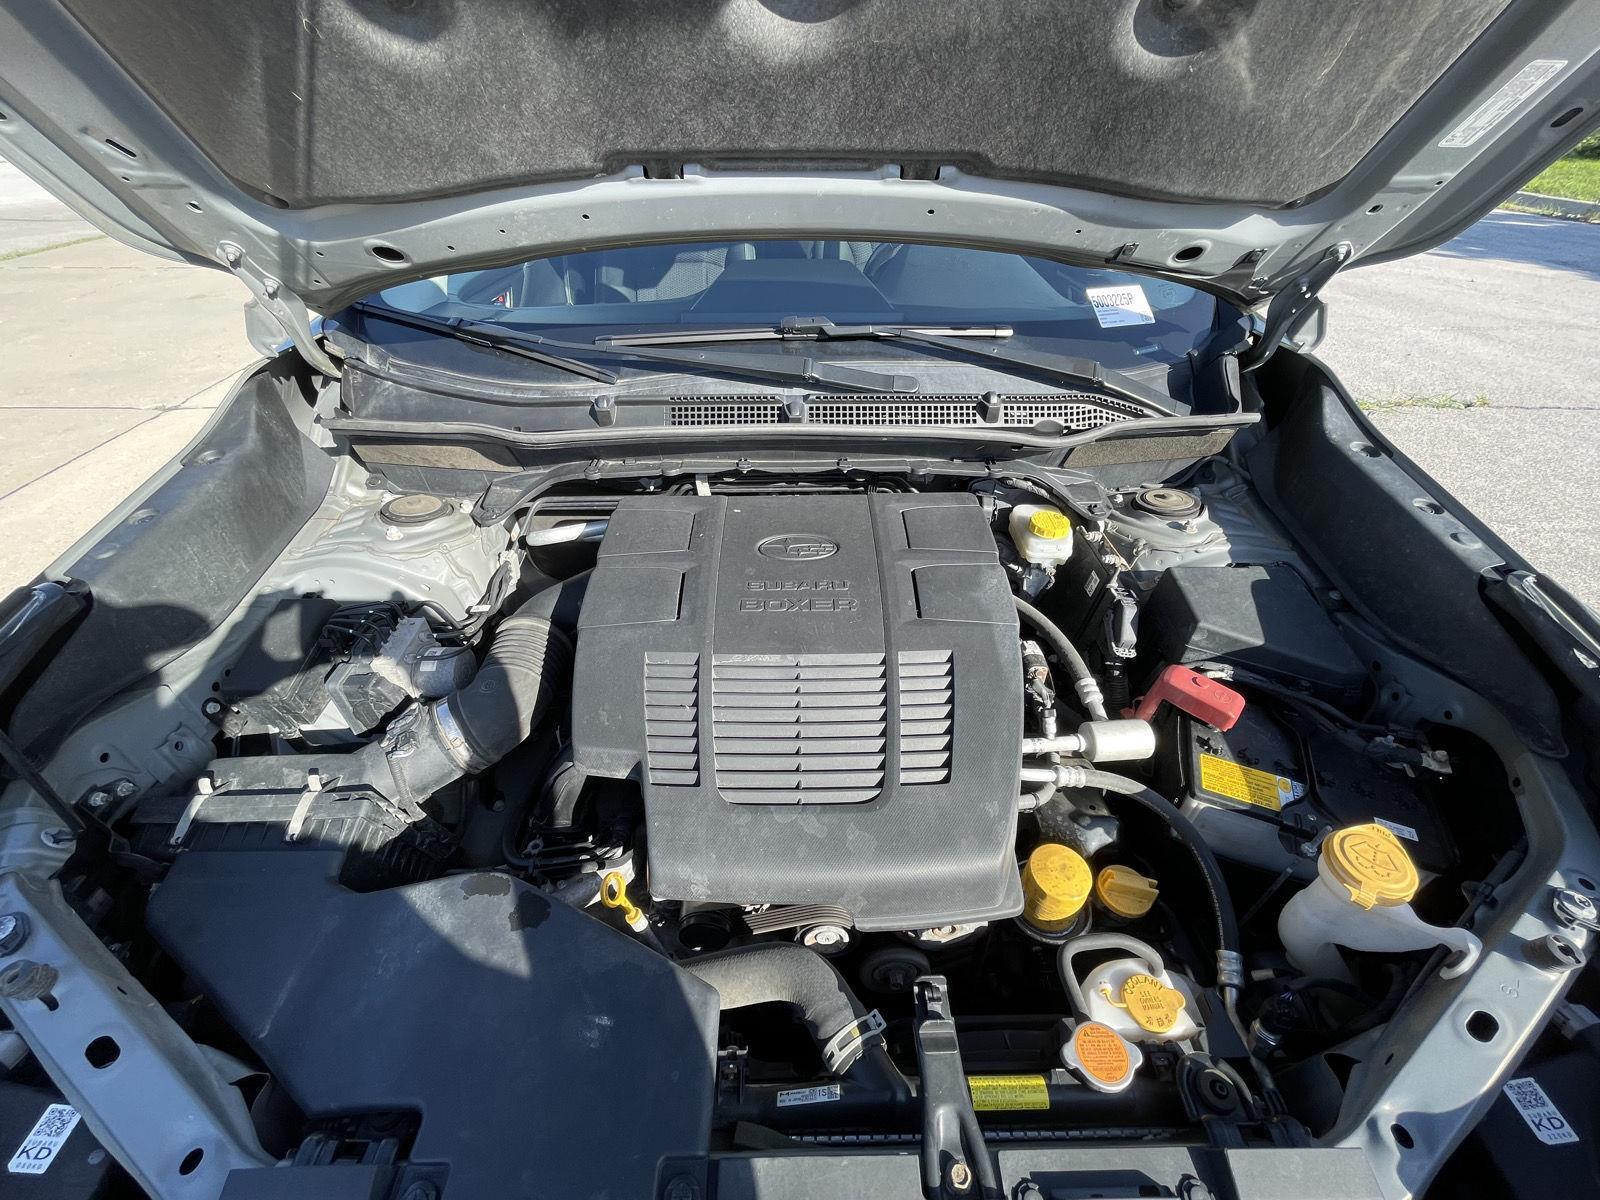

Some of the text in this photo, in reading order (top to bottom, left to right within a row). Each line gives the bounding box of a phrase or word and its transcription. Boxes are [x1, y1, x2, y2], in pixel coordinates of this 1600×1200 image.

[1091, 292, 1133, 309] 5003225P
[747, 580, 850, 591] SUBARU
[740, 598, 858, 612] BOXER
[1124, 976, 1163, 995] COOLANT
[1531, 1116, 1565, 1132] KD
[16, 1145, 52, 1160] KD
